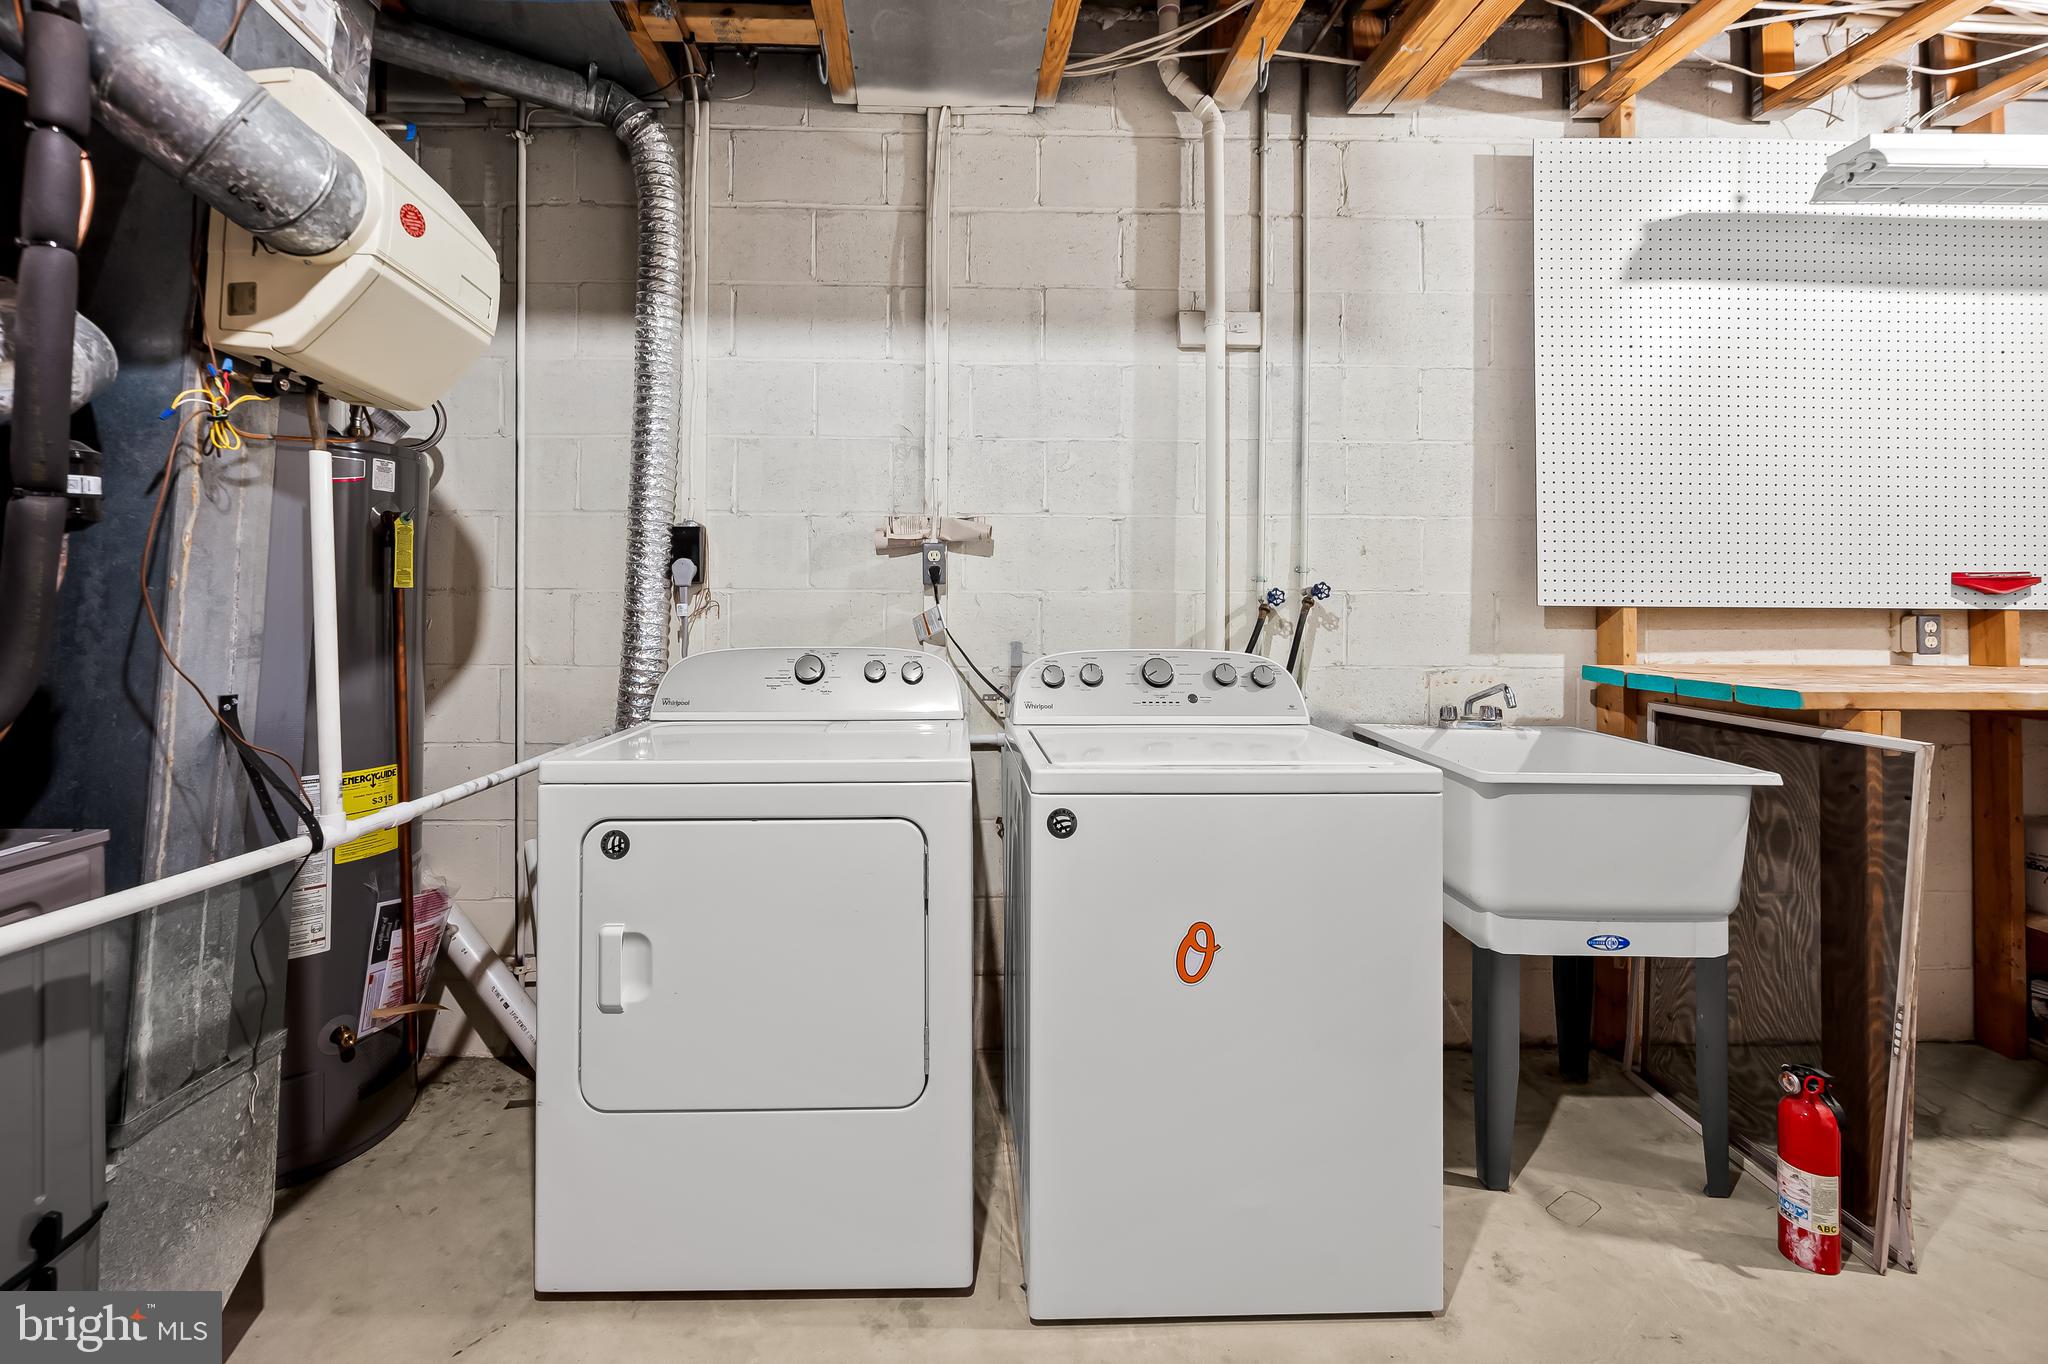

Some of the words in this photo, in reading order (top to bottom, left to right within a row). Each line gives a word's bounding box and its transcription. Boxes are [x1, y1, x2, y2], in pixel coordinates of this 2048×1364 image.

[662, 699, 690, 707] Whirlpool
[1024, 703, 1054, 711] Whirlpool
[1175, 921, 1222, 984] O
[1817, 1224, 1837, 1233] ABC
